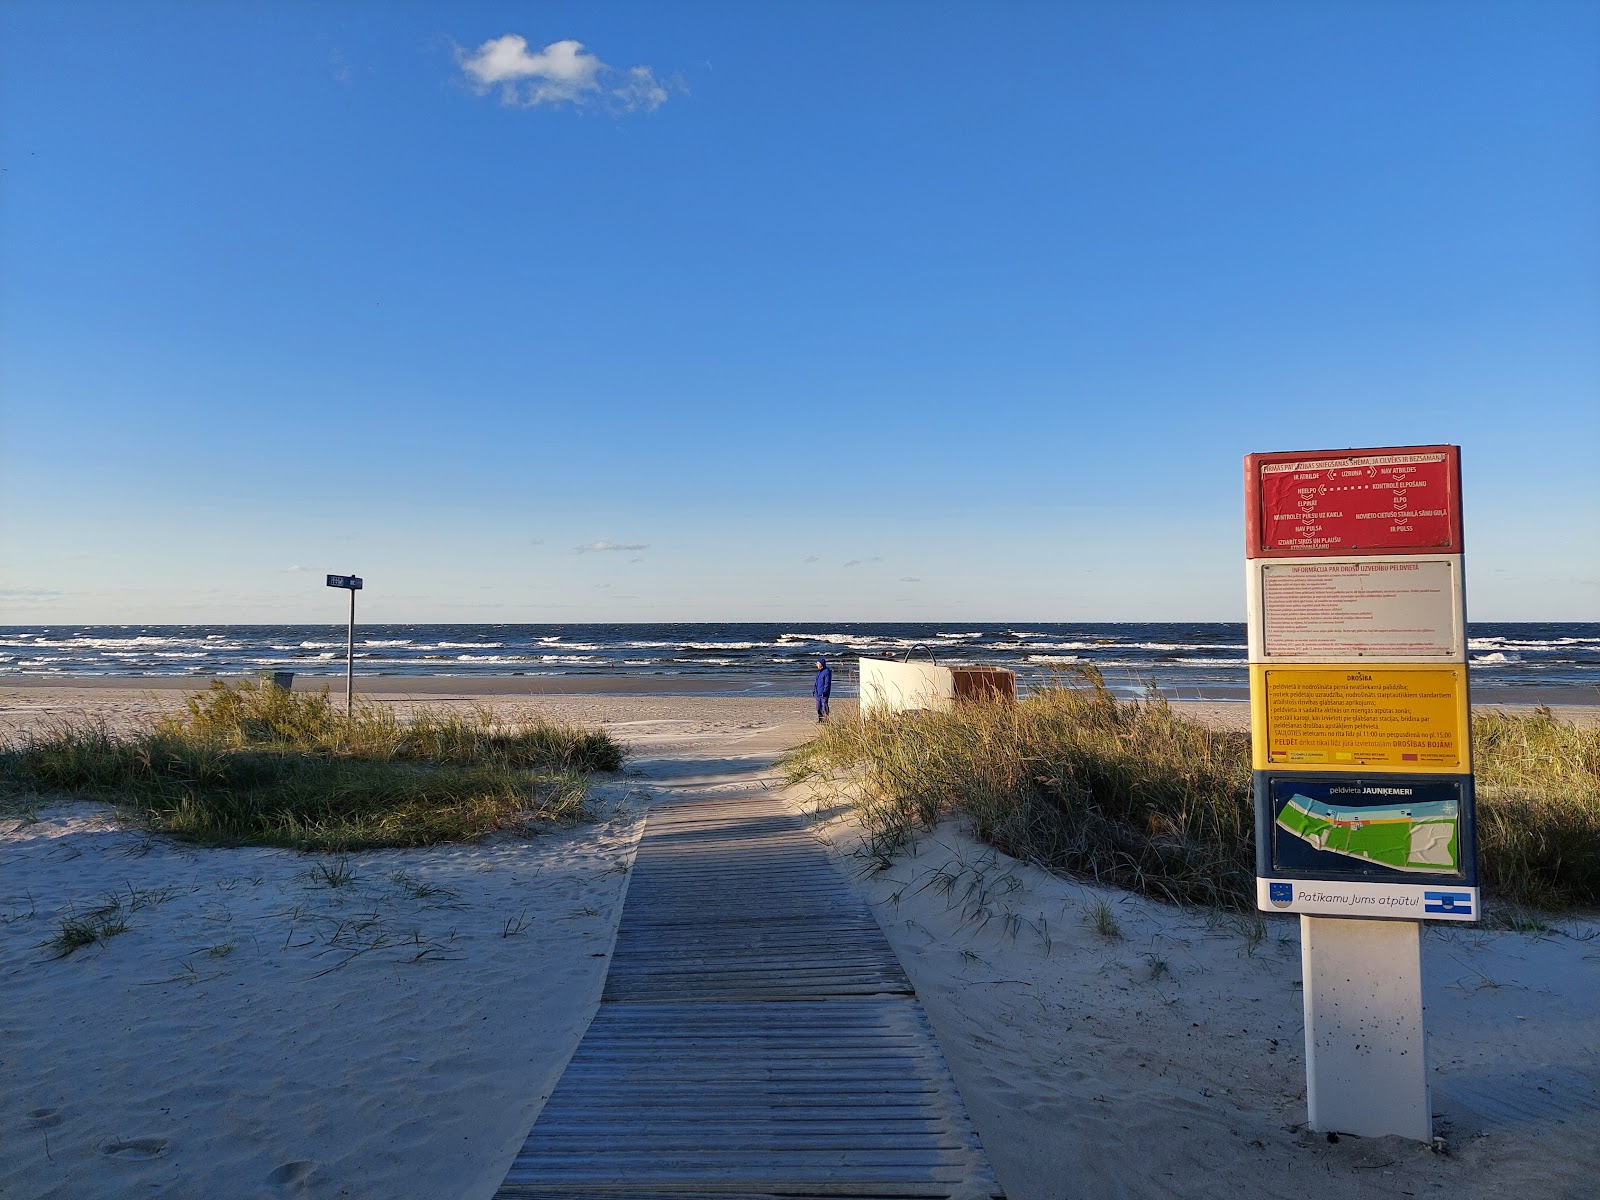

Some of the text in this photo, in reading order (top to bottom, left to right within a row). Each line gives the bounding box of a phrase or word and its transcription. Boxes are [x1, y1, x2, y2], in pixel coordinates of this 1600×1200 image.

[1372, 457, 1379, 465] JA
[1292, 565, 1327, 573] INFORMĀCIJA
[1379, 730, 1385, 738] un
[1275, 738, 1297, 747] PELDĒT
[1393, 740, 1426, 748] DROŠĪBAS
[1428, 740, 1453, 749] BOJĀM!
[1362, 788, 1412, 796] JAUNĶEMERI
[1298, 891, 1420, 907] Patīkamu Jums atpūtu!
